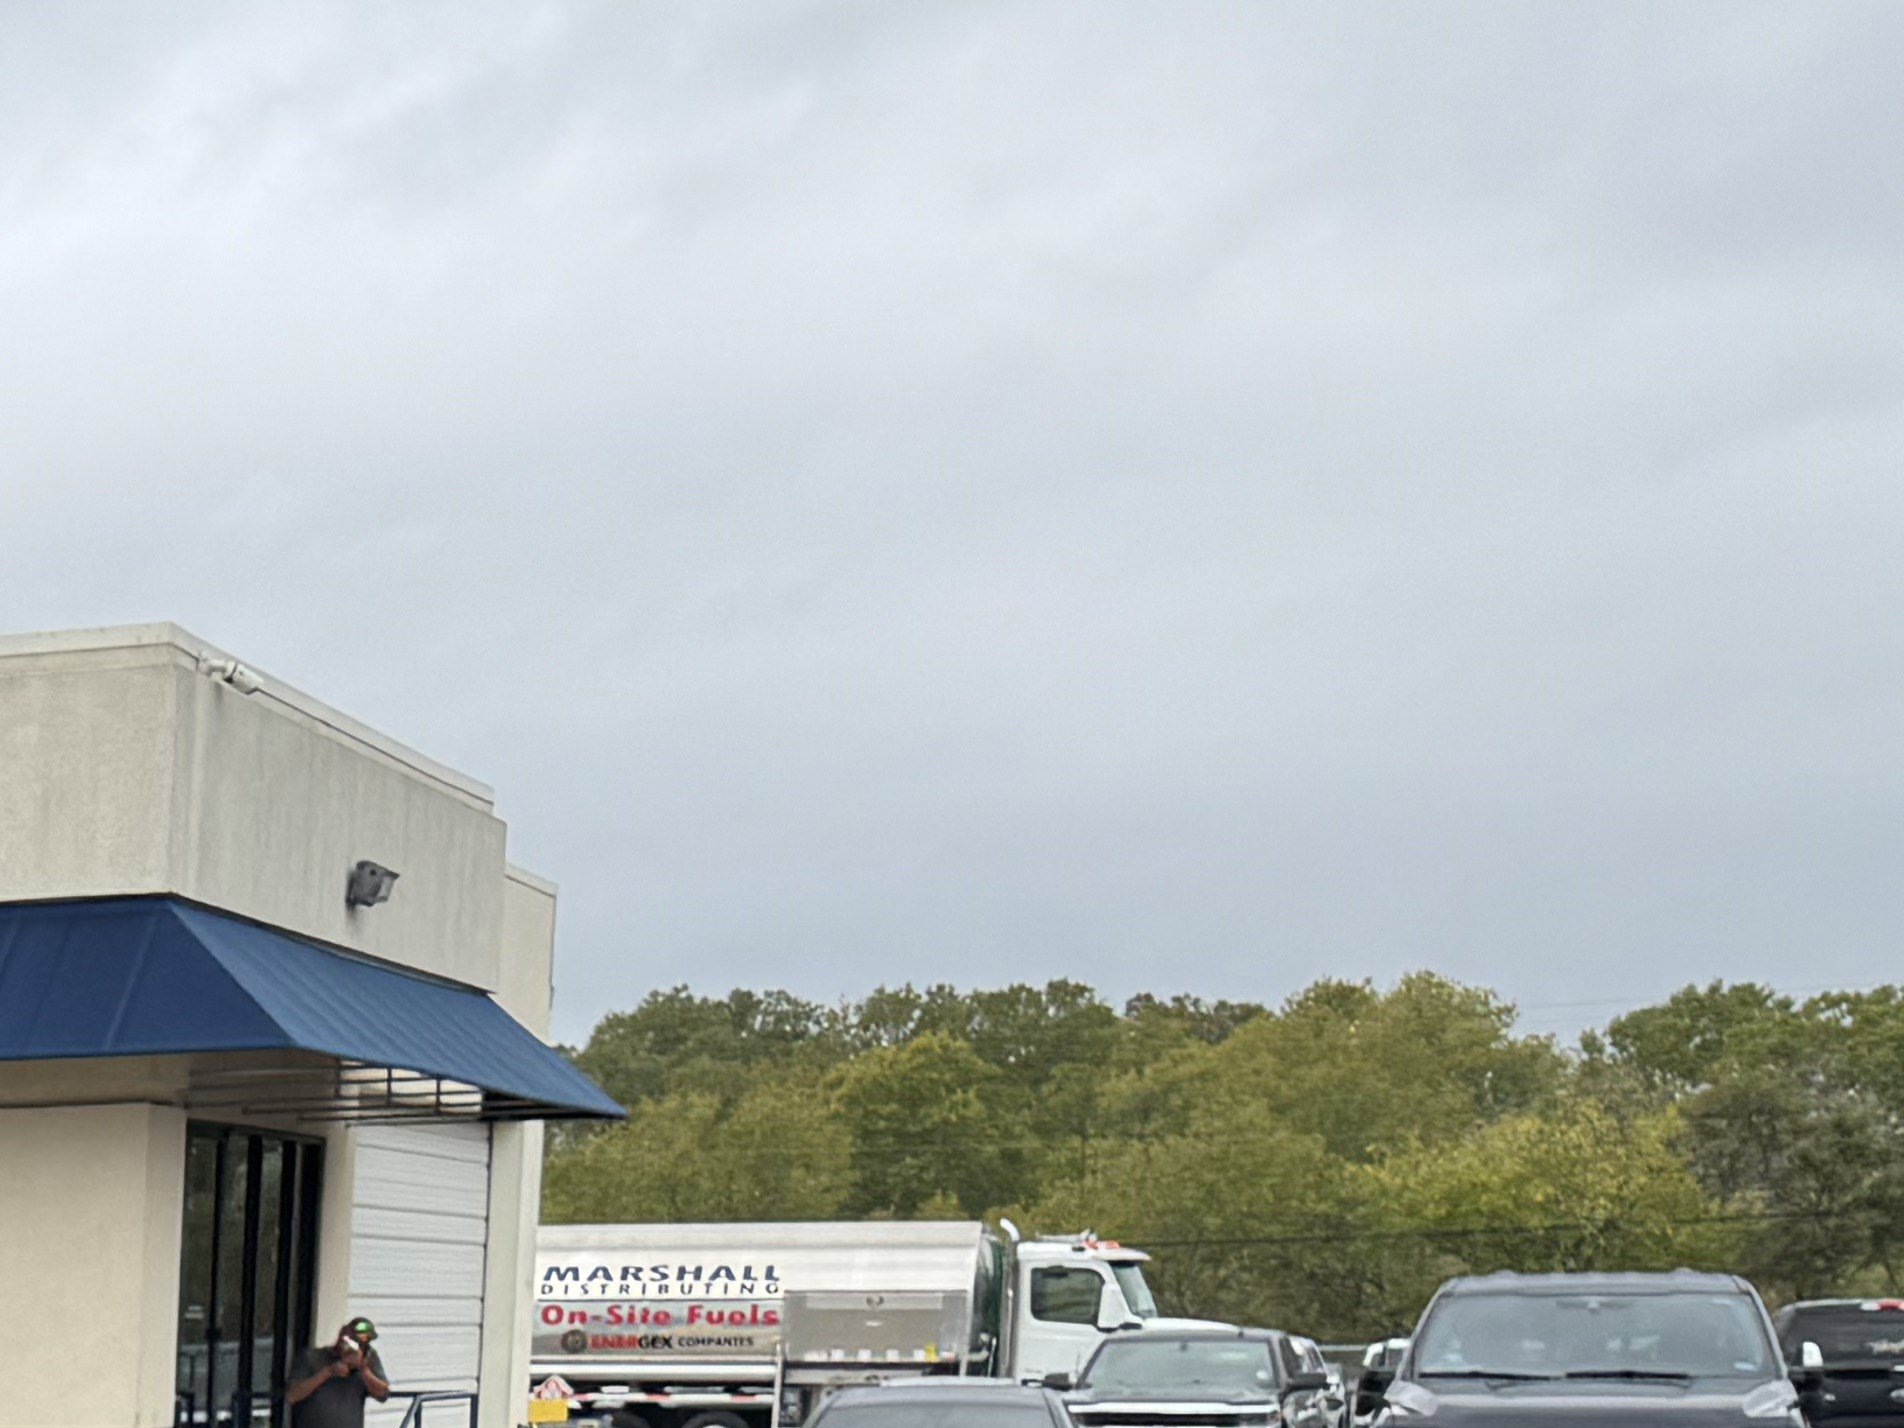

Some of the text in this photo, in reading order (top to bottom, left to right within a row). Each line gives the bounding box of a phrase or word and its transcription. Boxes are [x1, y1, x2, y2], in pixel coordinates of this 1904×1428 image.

[542, 1264, 781, 1282] MARSHALL
[540, 1304, 780, 1326] On-Site Fuels
